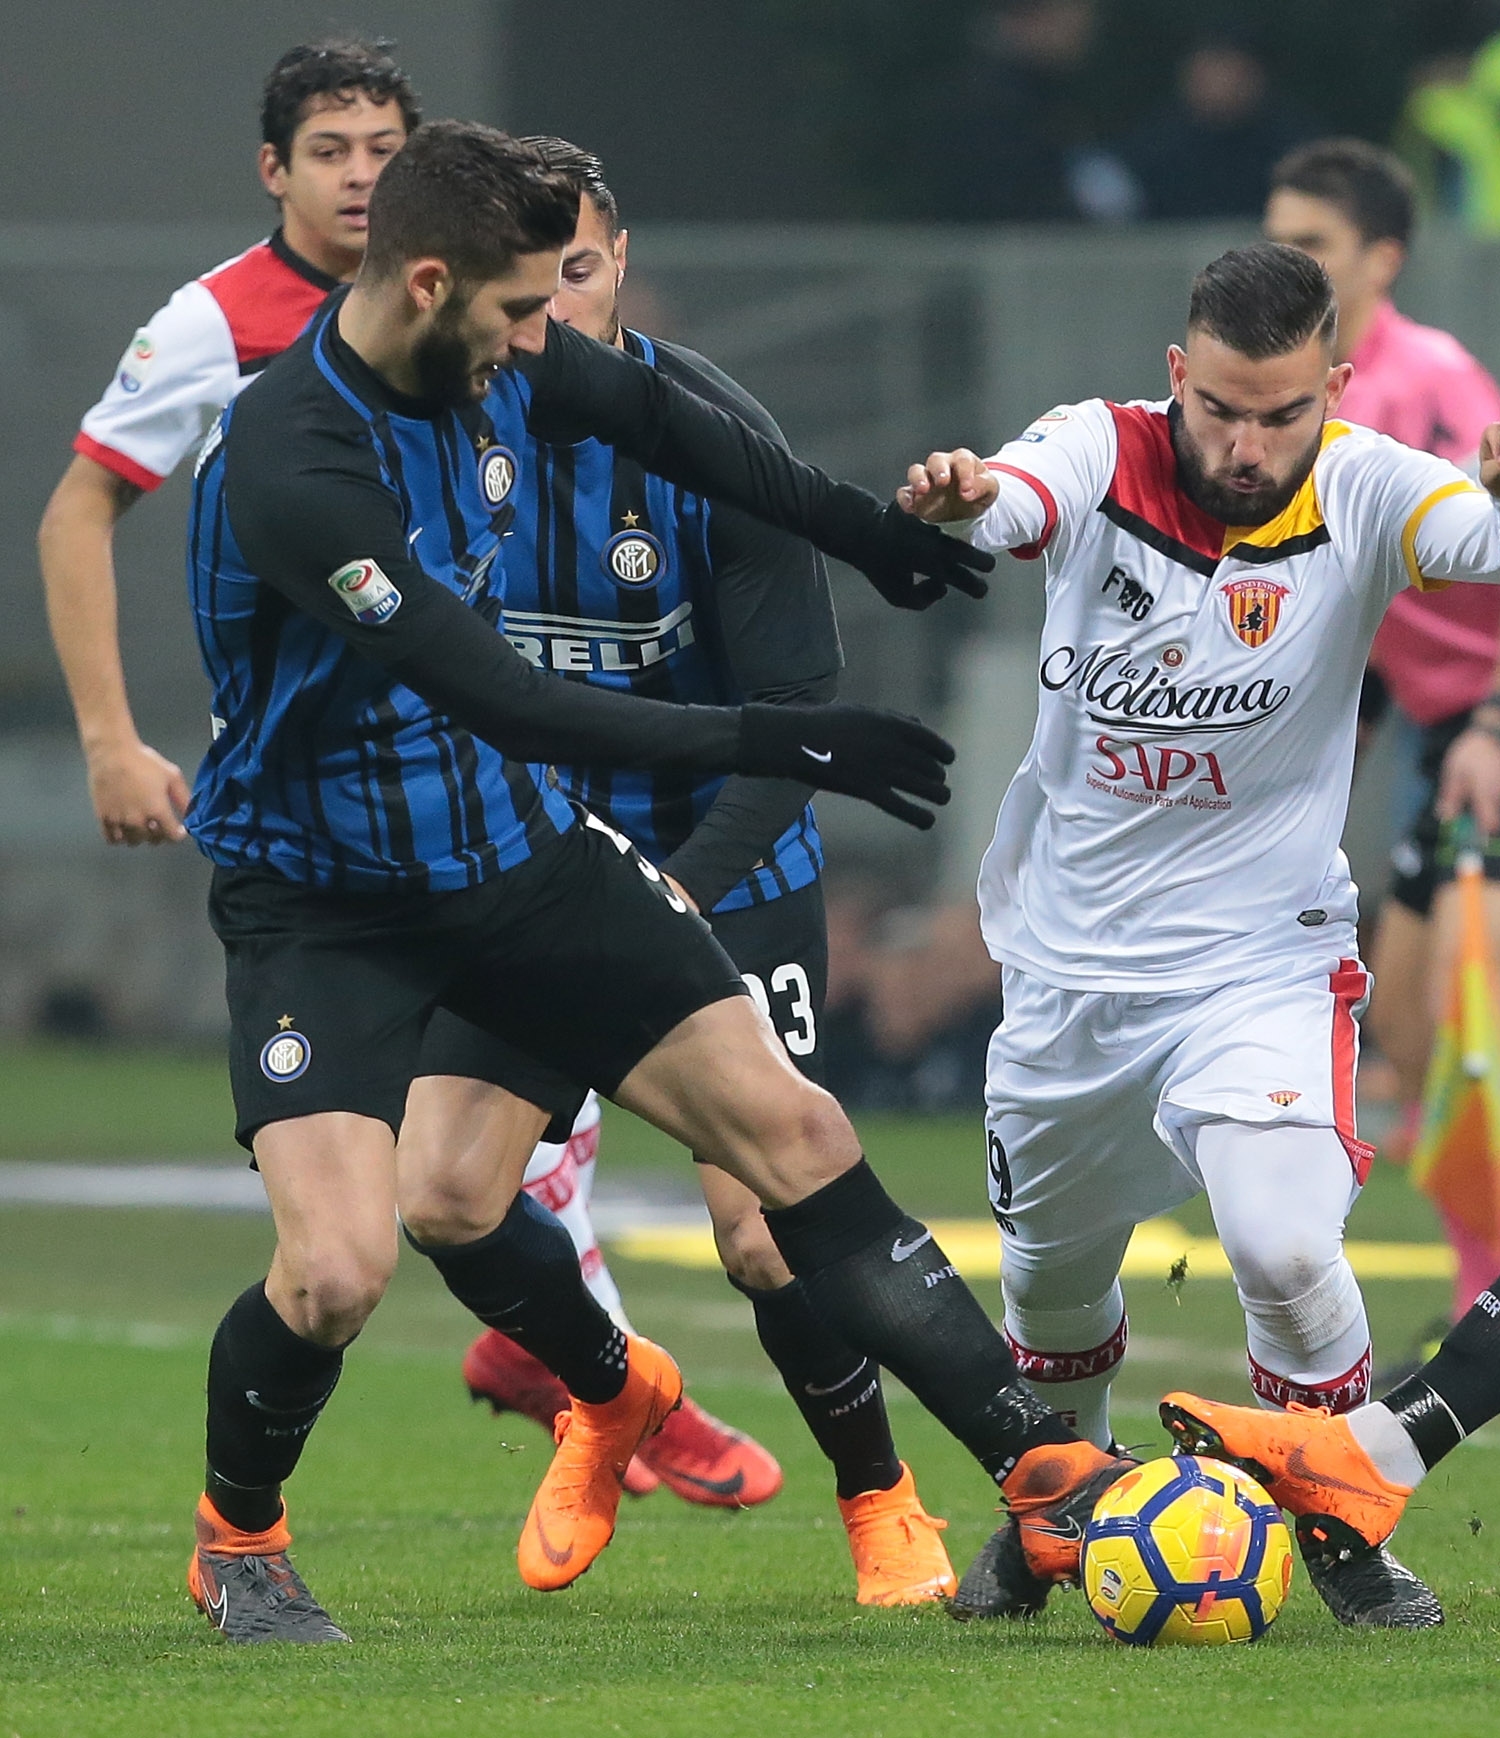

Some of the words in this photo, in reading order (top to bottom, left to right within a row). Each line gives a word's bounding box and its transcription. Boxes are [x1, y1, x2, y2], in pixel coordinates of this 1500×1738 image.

[372, 596, 395, 616] TIM
[503, 601, 695, 671] RELLI
[1040, 644, 1291, 719] Molisana
[1118, 659, 1141, 680] la
[1092, 735, 1228, 796] SAPA
[1085, 772, 1112, 794] Superior
[1113, 785, 1152, 805] Automotive
[1155, 793, 1173, 807] Parts
[1189, 795, 1232, 811] Application
